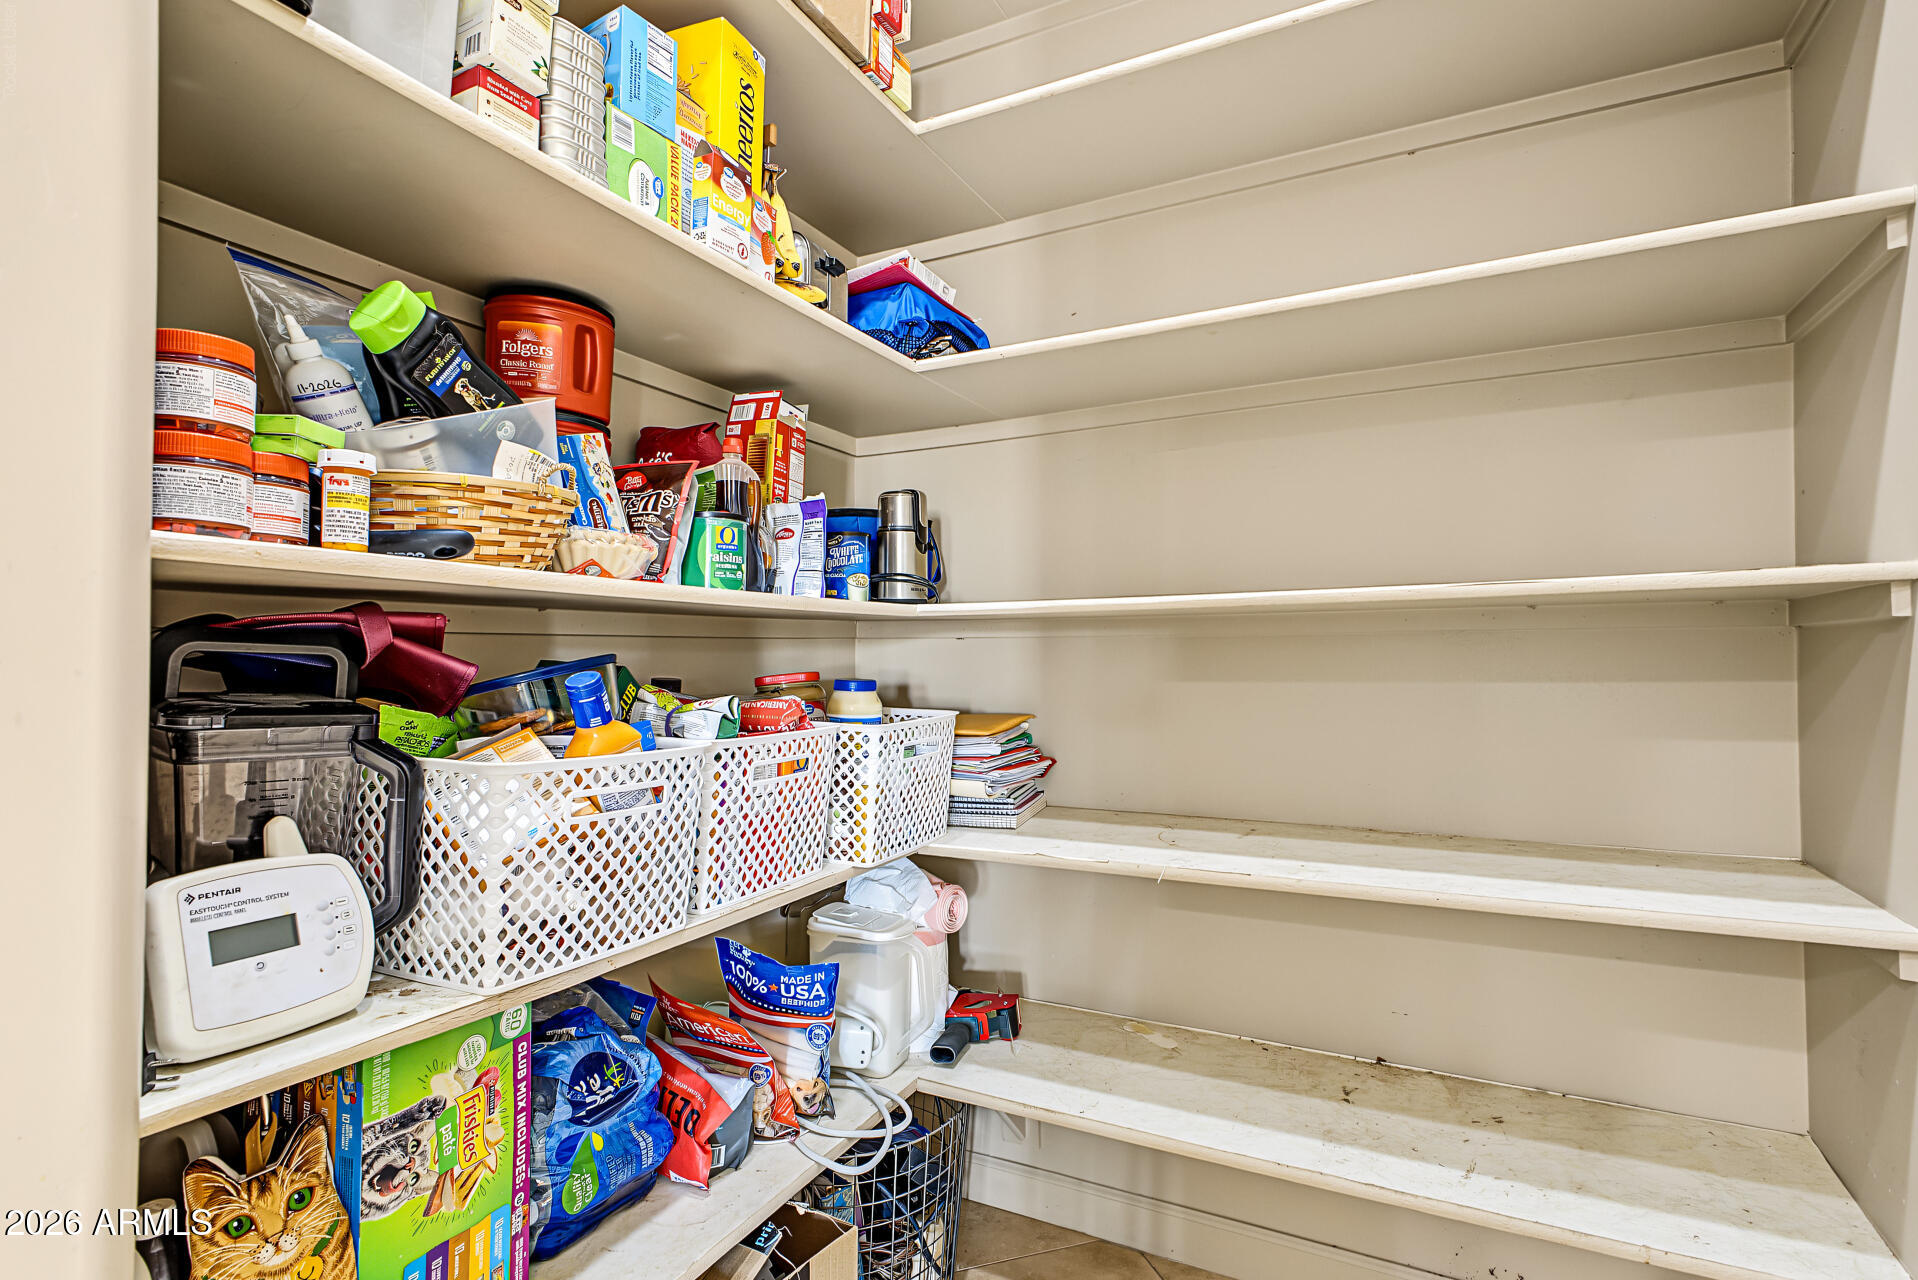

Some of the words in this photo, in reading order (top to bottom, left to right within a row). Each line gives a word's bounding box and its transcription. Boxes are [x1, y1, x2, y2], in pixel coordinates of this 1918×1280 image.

[670, 144, 680, 181] VALUE
[670, 182, 680, 216] PACK
[712, 193, 751, 228] Energy
[502, 340, 553, 357] Folgers
[500, 358, 528, 368] Classic
[529, 360, 555, 371] Roast
[296, 379, 342, 394] 11-2026
[711, 551, 743, 564] aisins
[830, 544, 860, 559] WHITE
[198, 887, 242, 900] PENTAIR
[233, 896, 265, 908] CONTROL
[265, 891, 290, 901] SYSTEM
[730, 961, 768, 994] 100%
[781, 974, 812, 985] MADE
[814, 971, 825, 982] IN
[780, 983, 826, 1000] USA
[511, 1007, 523, 1031] 60
[666, 1012, 750, 1045] American
[517, 1041, 527, 1080] CLUB
[303, 1100, 311, 1112] 10
[517, 1081, 527, 1111] MIX
[342, 1113, 350, 1124] 10
[462, 1092, 481, 1163] Friskies
[515, 1111, 527, 1189] INCLUDES:
[572, 1173, 584, 1212] Quality
[584, 1173, 593, 1203] Clear
